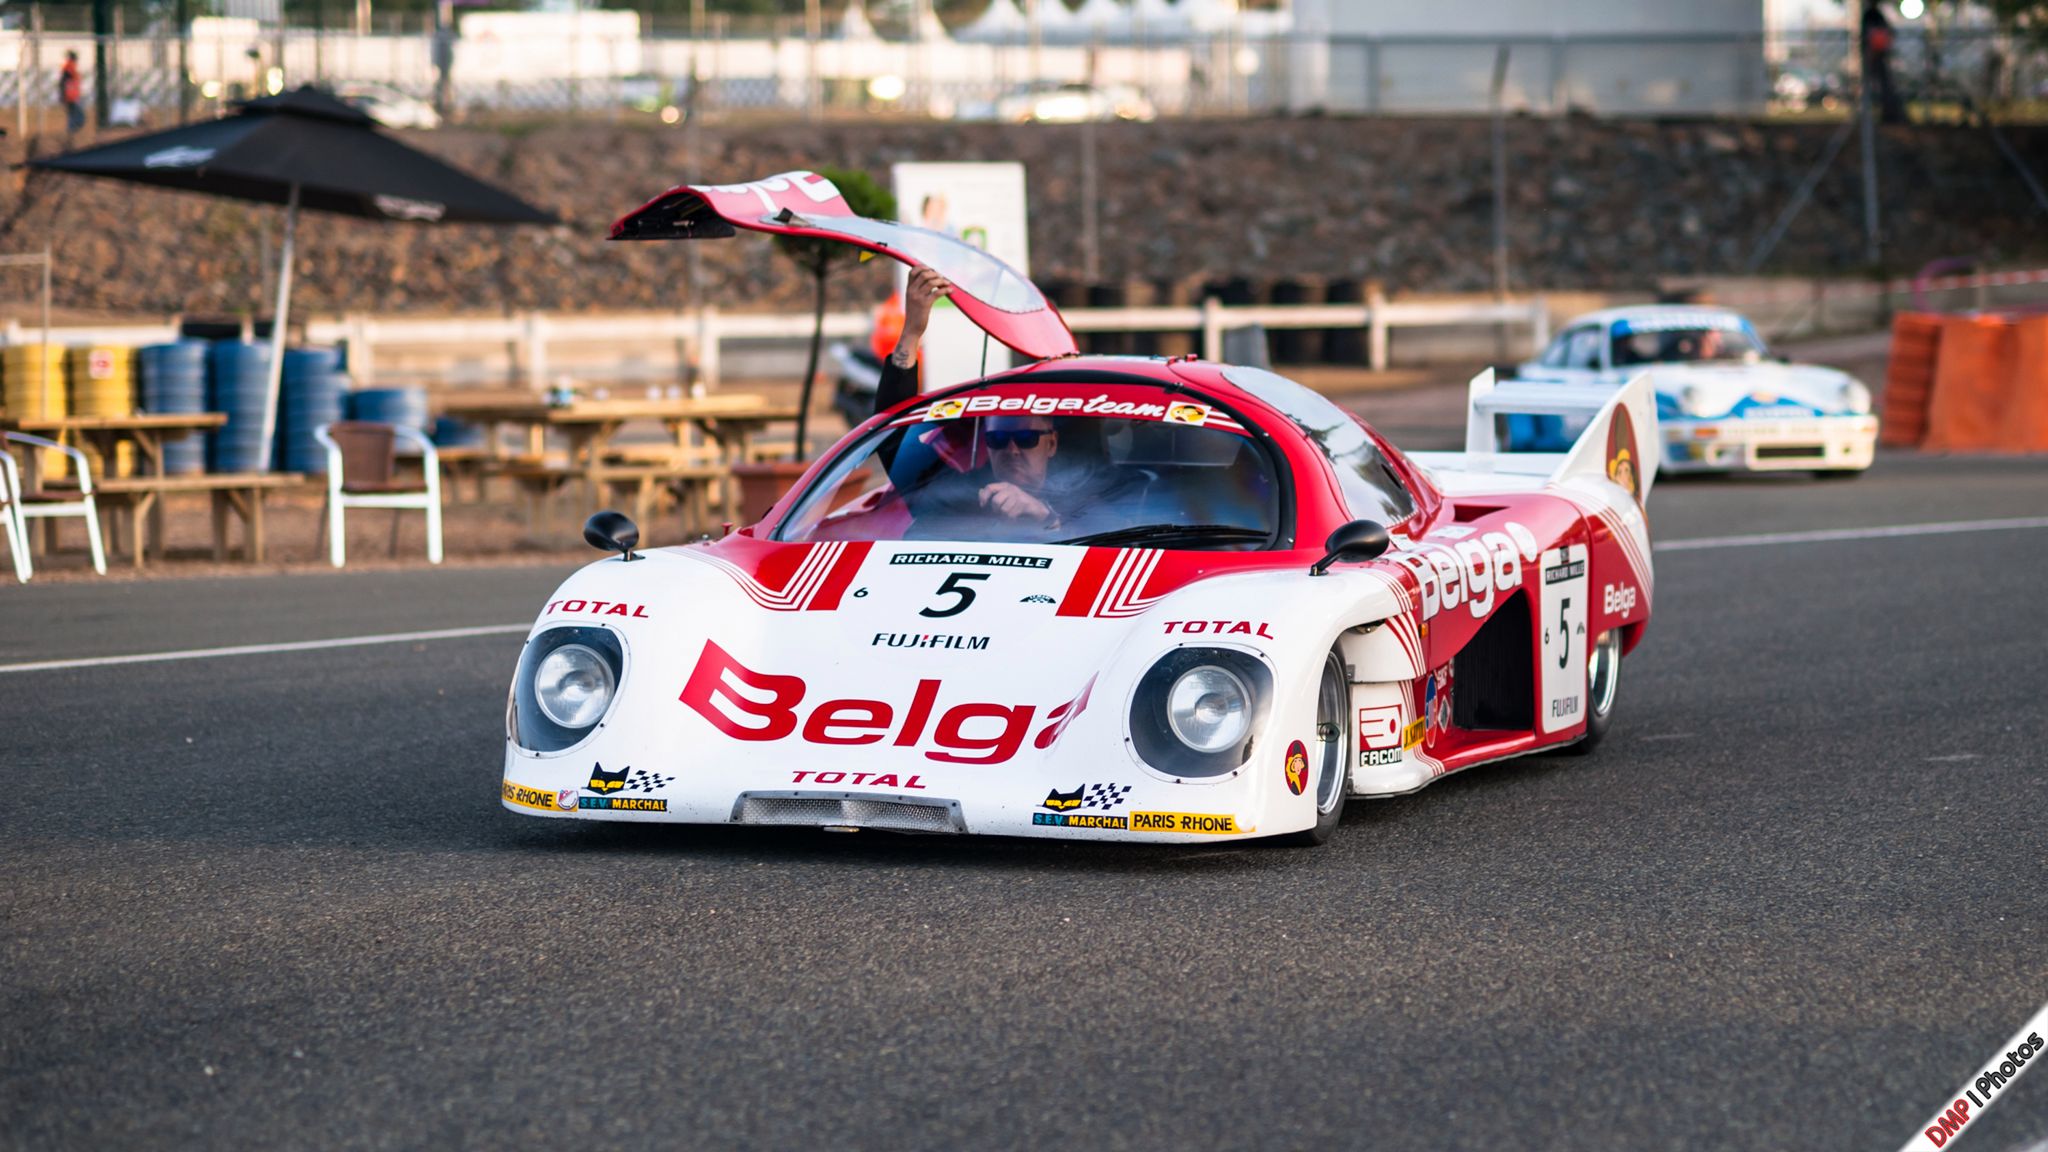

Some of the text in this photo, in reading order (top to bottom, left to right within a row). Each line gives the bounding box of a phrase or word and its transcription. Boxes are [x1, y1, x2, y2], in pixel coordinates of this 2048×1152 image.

[893, 554, 1048, 568] RICHARD MILLE
[1384, 531, 1523, 621] Belga
[853, 587, 869, 598] 6
[918, 572, 991, 618] 5
[1604, 581, 1636, 619] Belga
[546, 600, 649, 618] TOTAL
[1163, 620, 1274, 640] TOTAL
[1544, 627, 1550, 645] 6
[1559, 597, 1570, 669] 5
[871, 633, 990, 650] FUJIFILM
[1360, 747, 1402, 766] FACOM
[792, 771, 926, 789] TOTAL
[517, 787, 553, 808] RHONE
[612, 798, 666, 811] MARCHAL
[1068, 816, 1126, 828] MARCHAL
[1134, 814, 1175, 829] PARIS
